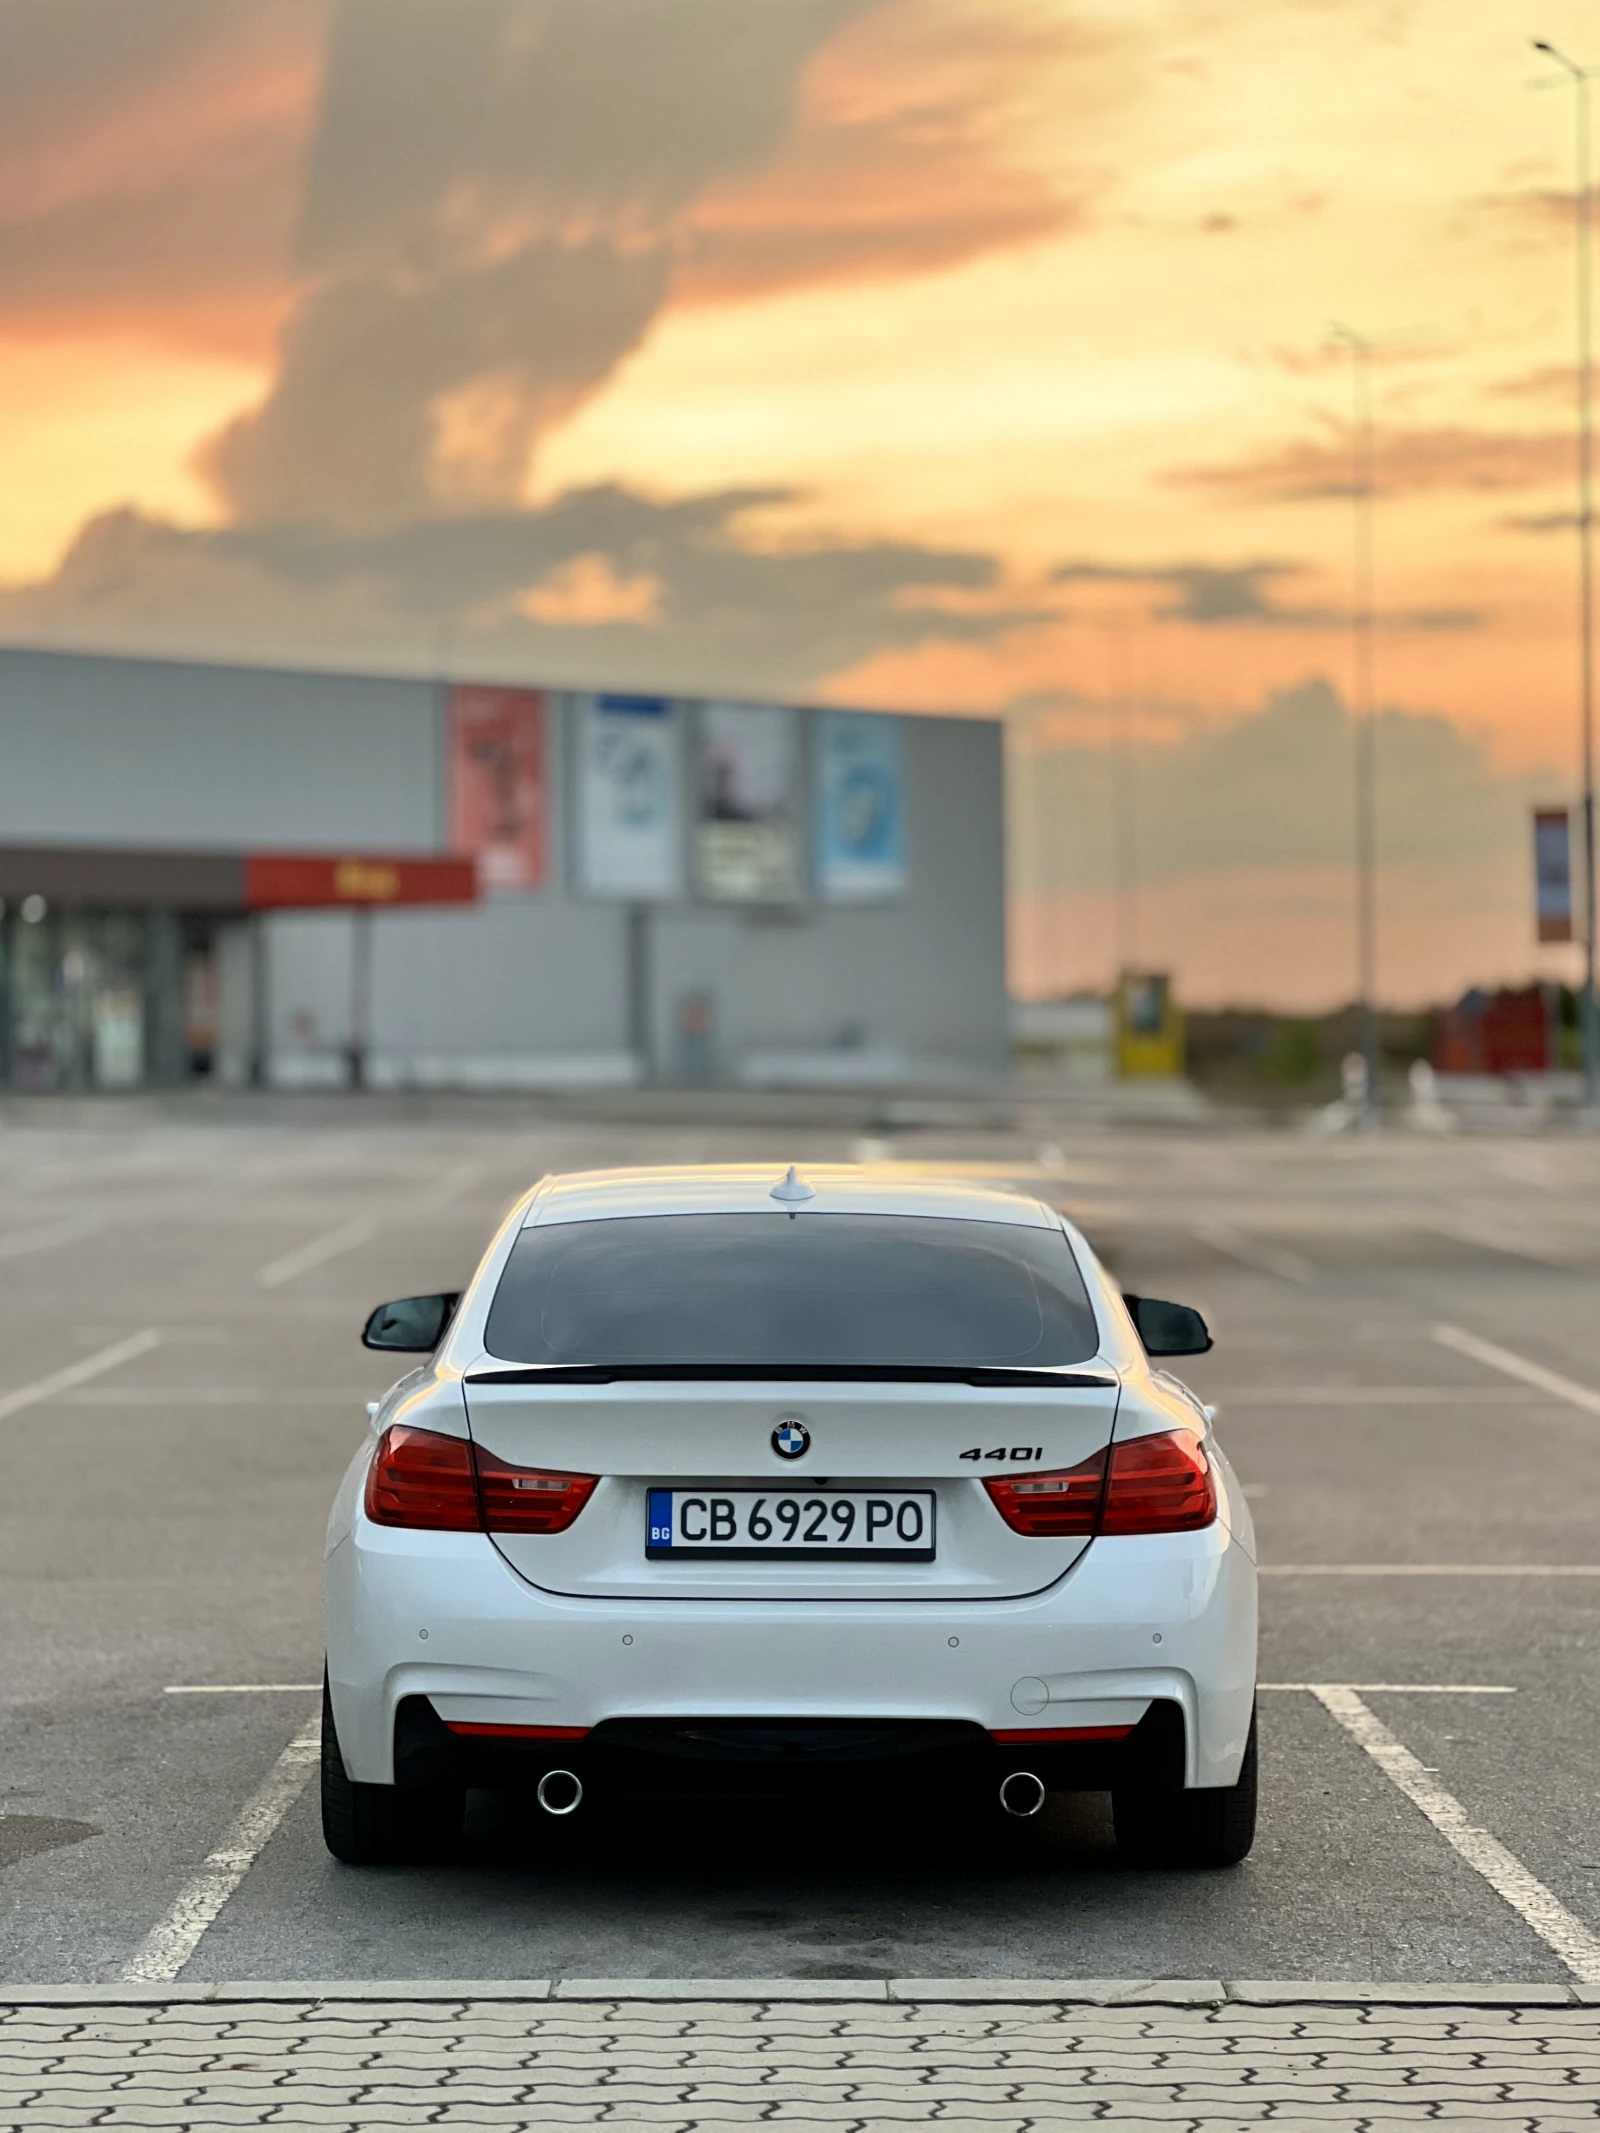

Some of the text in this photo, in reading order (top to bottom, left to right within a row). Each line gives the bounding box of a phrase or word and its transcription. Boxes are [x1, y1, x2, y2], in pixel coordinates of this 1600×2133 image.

[774, 1421, 808, 1434] BMW
[680, 1498, 737, 1541] CB
[748, 1498, 856, 1542] 6929
[651, 1527, 670, 1540] BG
